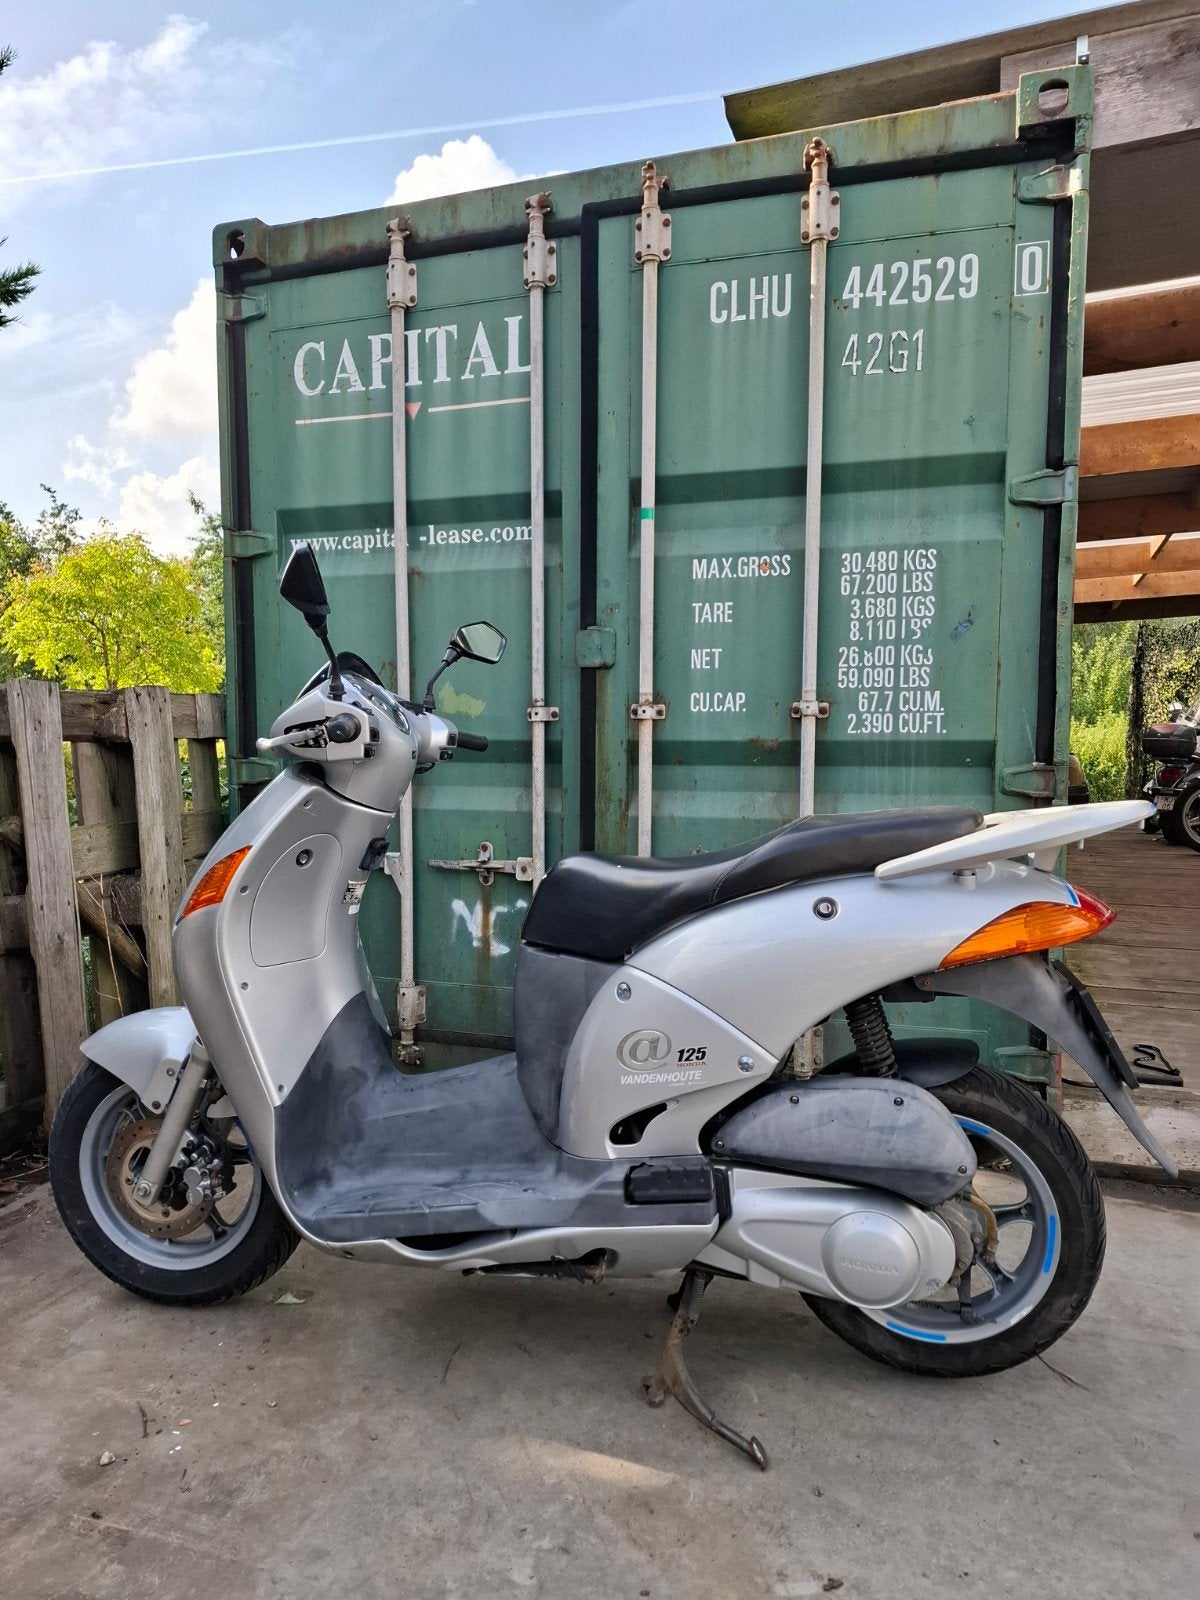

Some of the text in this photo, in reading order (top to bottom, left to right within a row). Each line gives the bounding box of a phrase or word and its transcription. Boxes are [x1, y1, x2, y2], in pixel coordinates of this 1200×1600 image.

[710, 246, 1043, 324] CLHU 442529 0
[294, 315, 532, 396] CAPITAL
[842, 329, 924, 376] 42G1
[290, 524, 532, 554] www.capit-lease.com
[692, 555, 791, 579] MAX.GROSS
[903, 549, 937, 571] KGS
[903, 571, 933, 594] LBS
[692, 602, 733, 623] TARE
[902, 596, 935, 617] KGS
[691, 648, 722, 669] NET
[900, 644, 934, 666] KGS
[900, 666, 930, 688] LBS
[690, 690, 944, 712] CU.CAP. 67.7 CU.M.
[899, 713, 947, 734] CU.FT.
[677, 1047, 707, 1062] 125
[620, 1070, 703, 1085] VANDENHOUTE
[840, 1256, 901, 1275] HONDA
